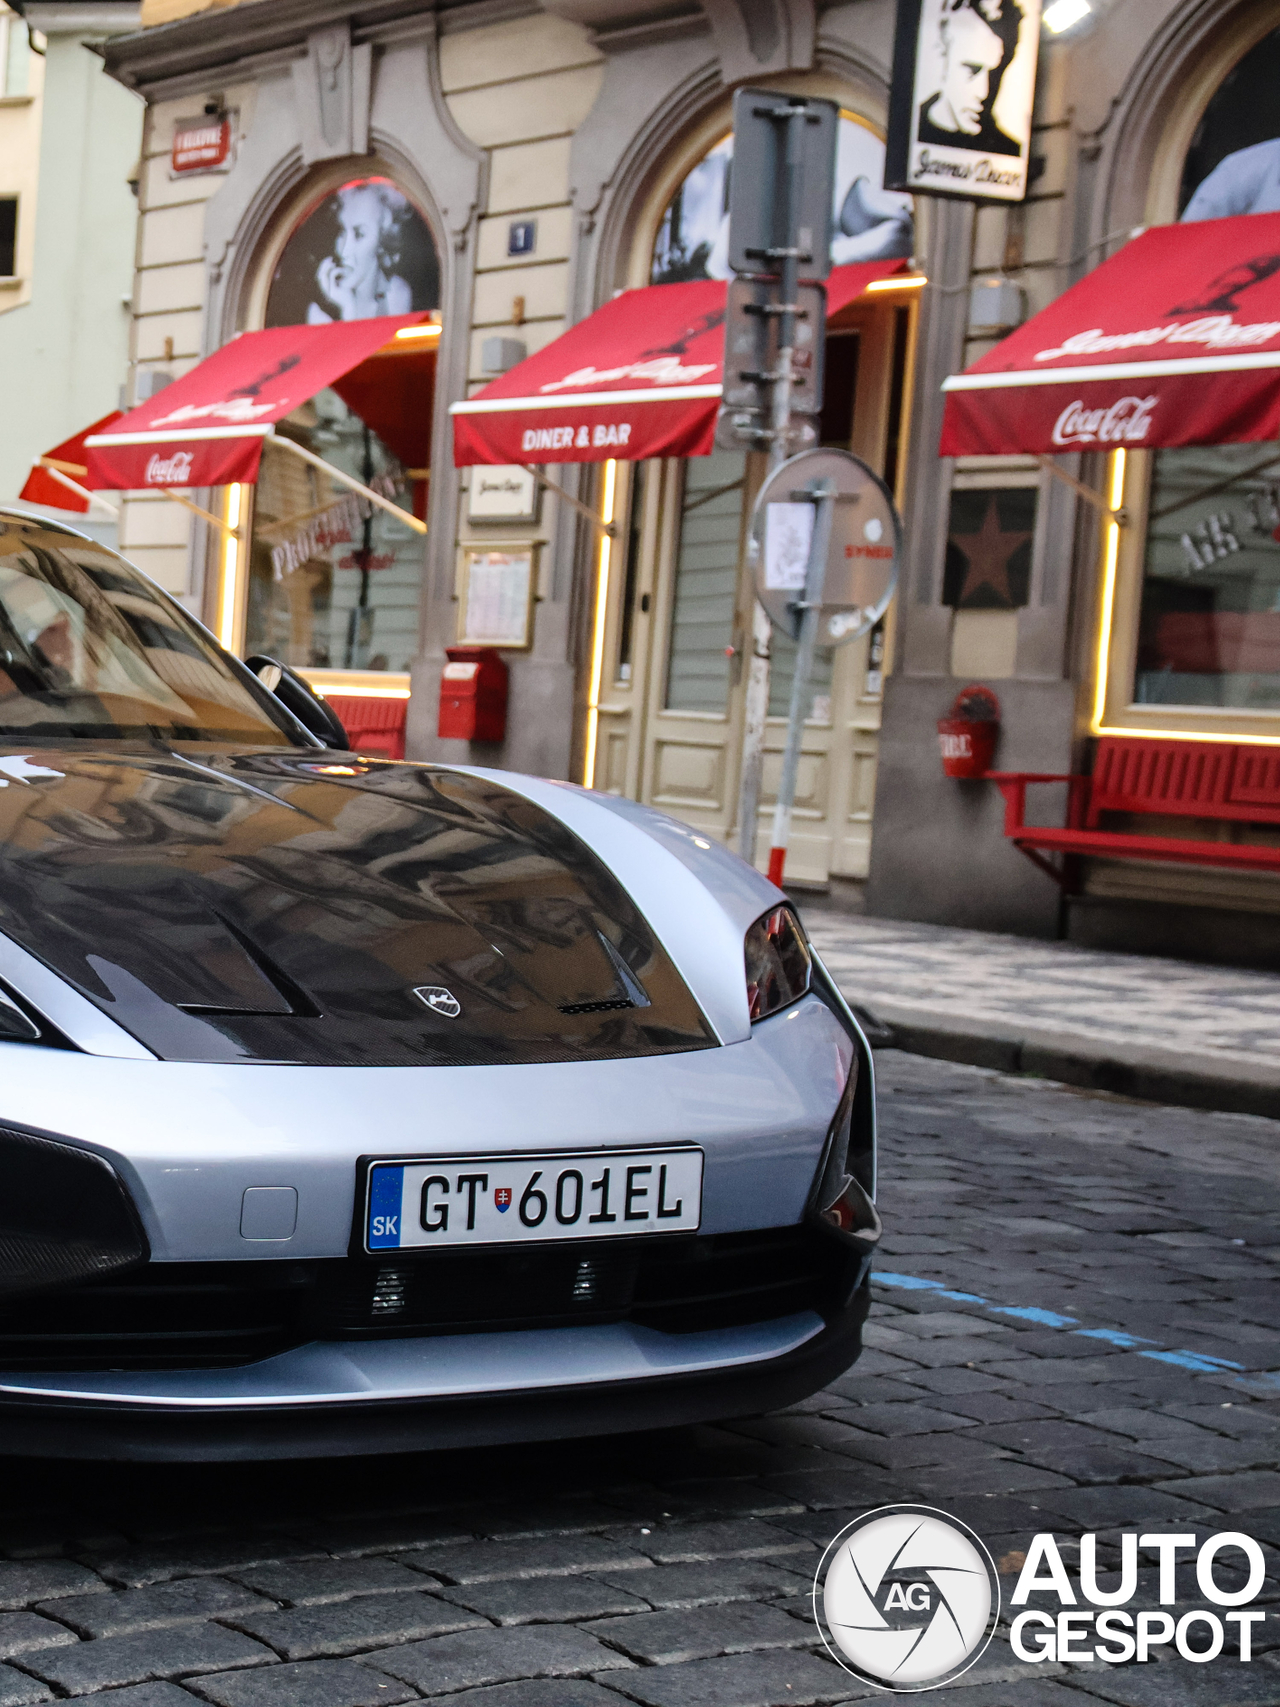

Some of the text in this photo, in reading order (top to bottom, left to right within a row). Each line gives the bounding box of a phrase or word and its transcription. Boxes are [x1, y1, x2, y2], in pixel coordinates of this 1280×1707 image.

[522, 423, 632, 452] DINER & BAR
[420, 1162, 683, 1232] GT 601EL
[372, 1216, 399, 1237] SK
